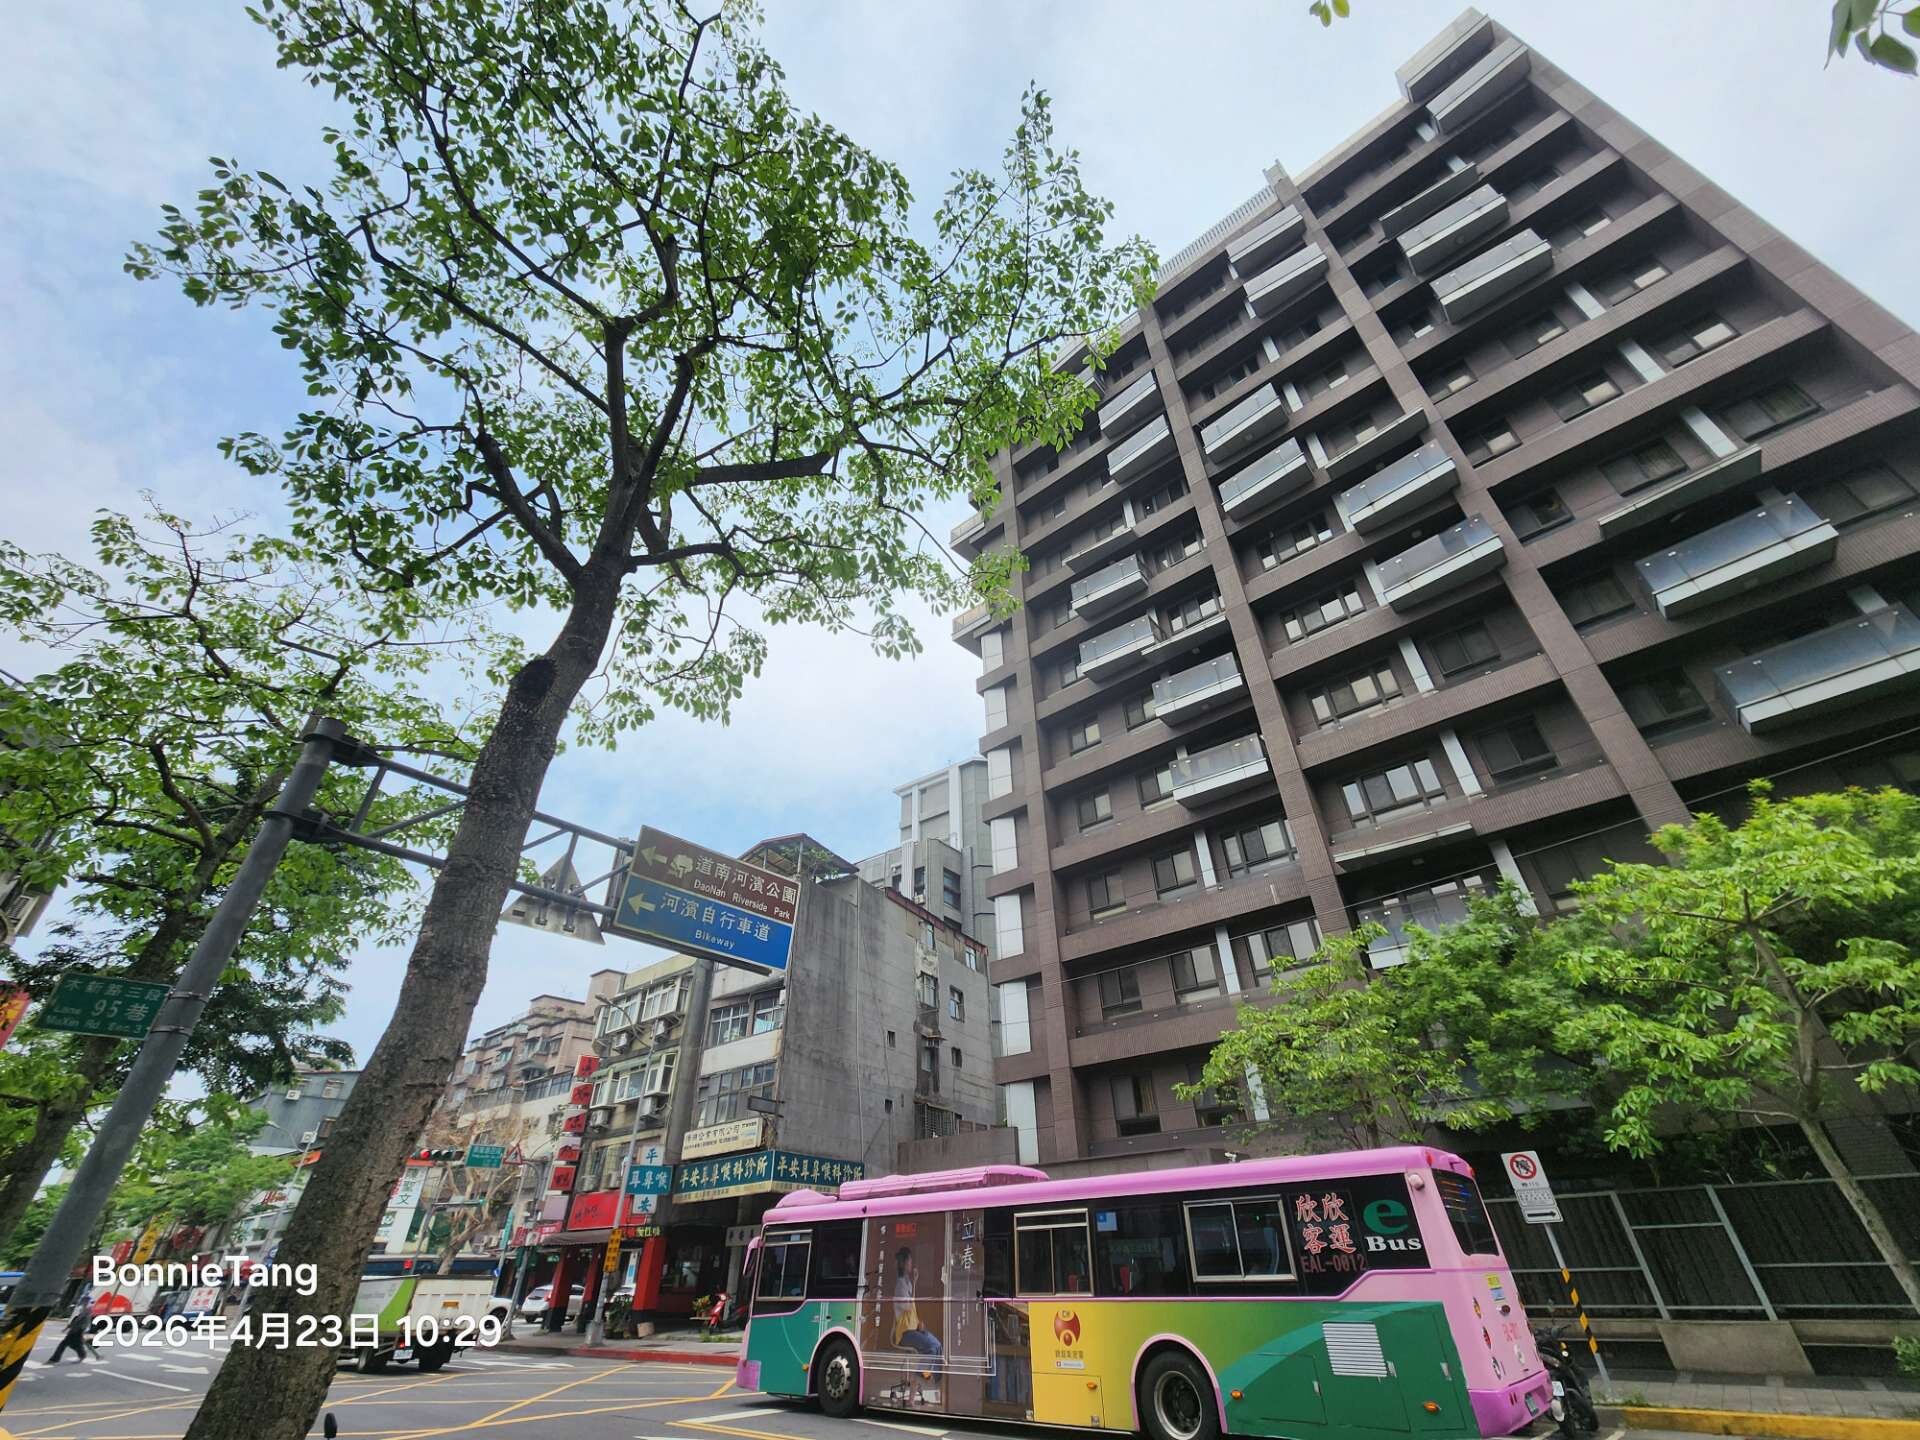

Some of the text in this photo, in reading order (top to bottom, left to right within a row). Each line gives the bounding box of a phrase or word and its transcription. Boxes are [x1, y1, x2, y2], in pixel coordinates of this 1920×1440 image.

[695, 855, 796, 905] 道南河濱公園
[693, 879, 790, 920] DaoNan Riverside Park
[660, 891, 771, 942] 河濱自行車道
[695, 929, 736, 949] Bikeway
[646, 1148, 658, 1165] 平
[679, 1155, 769, 1188] 平安耳鼻喉科診所
[629, 1170, 668, 1191] 耳鼻喉
[638, 1196, 651, 1212] 安
[1296, 1193, 1350, 1223] 欣欣
[1363, 1199, 1409, 1235] e
[961, 1220, 974, 1270] 立春
[1301, 1223, 1358, 1255] 客運
[1367, 1235, 1422, 1252] Bus
